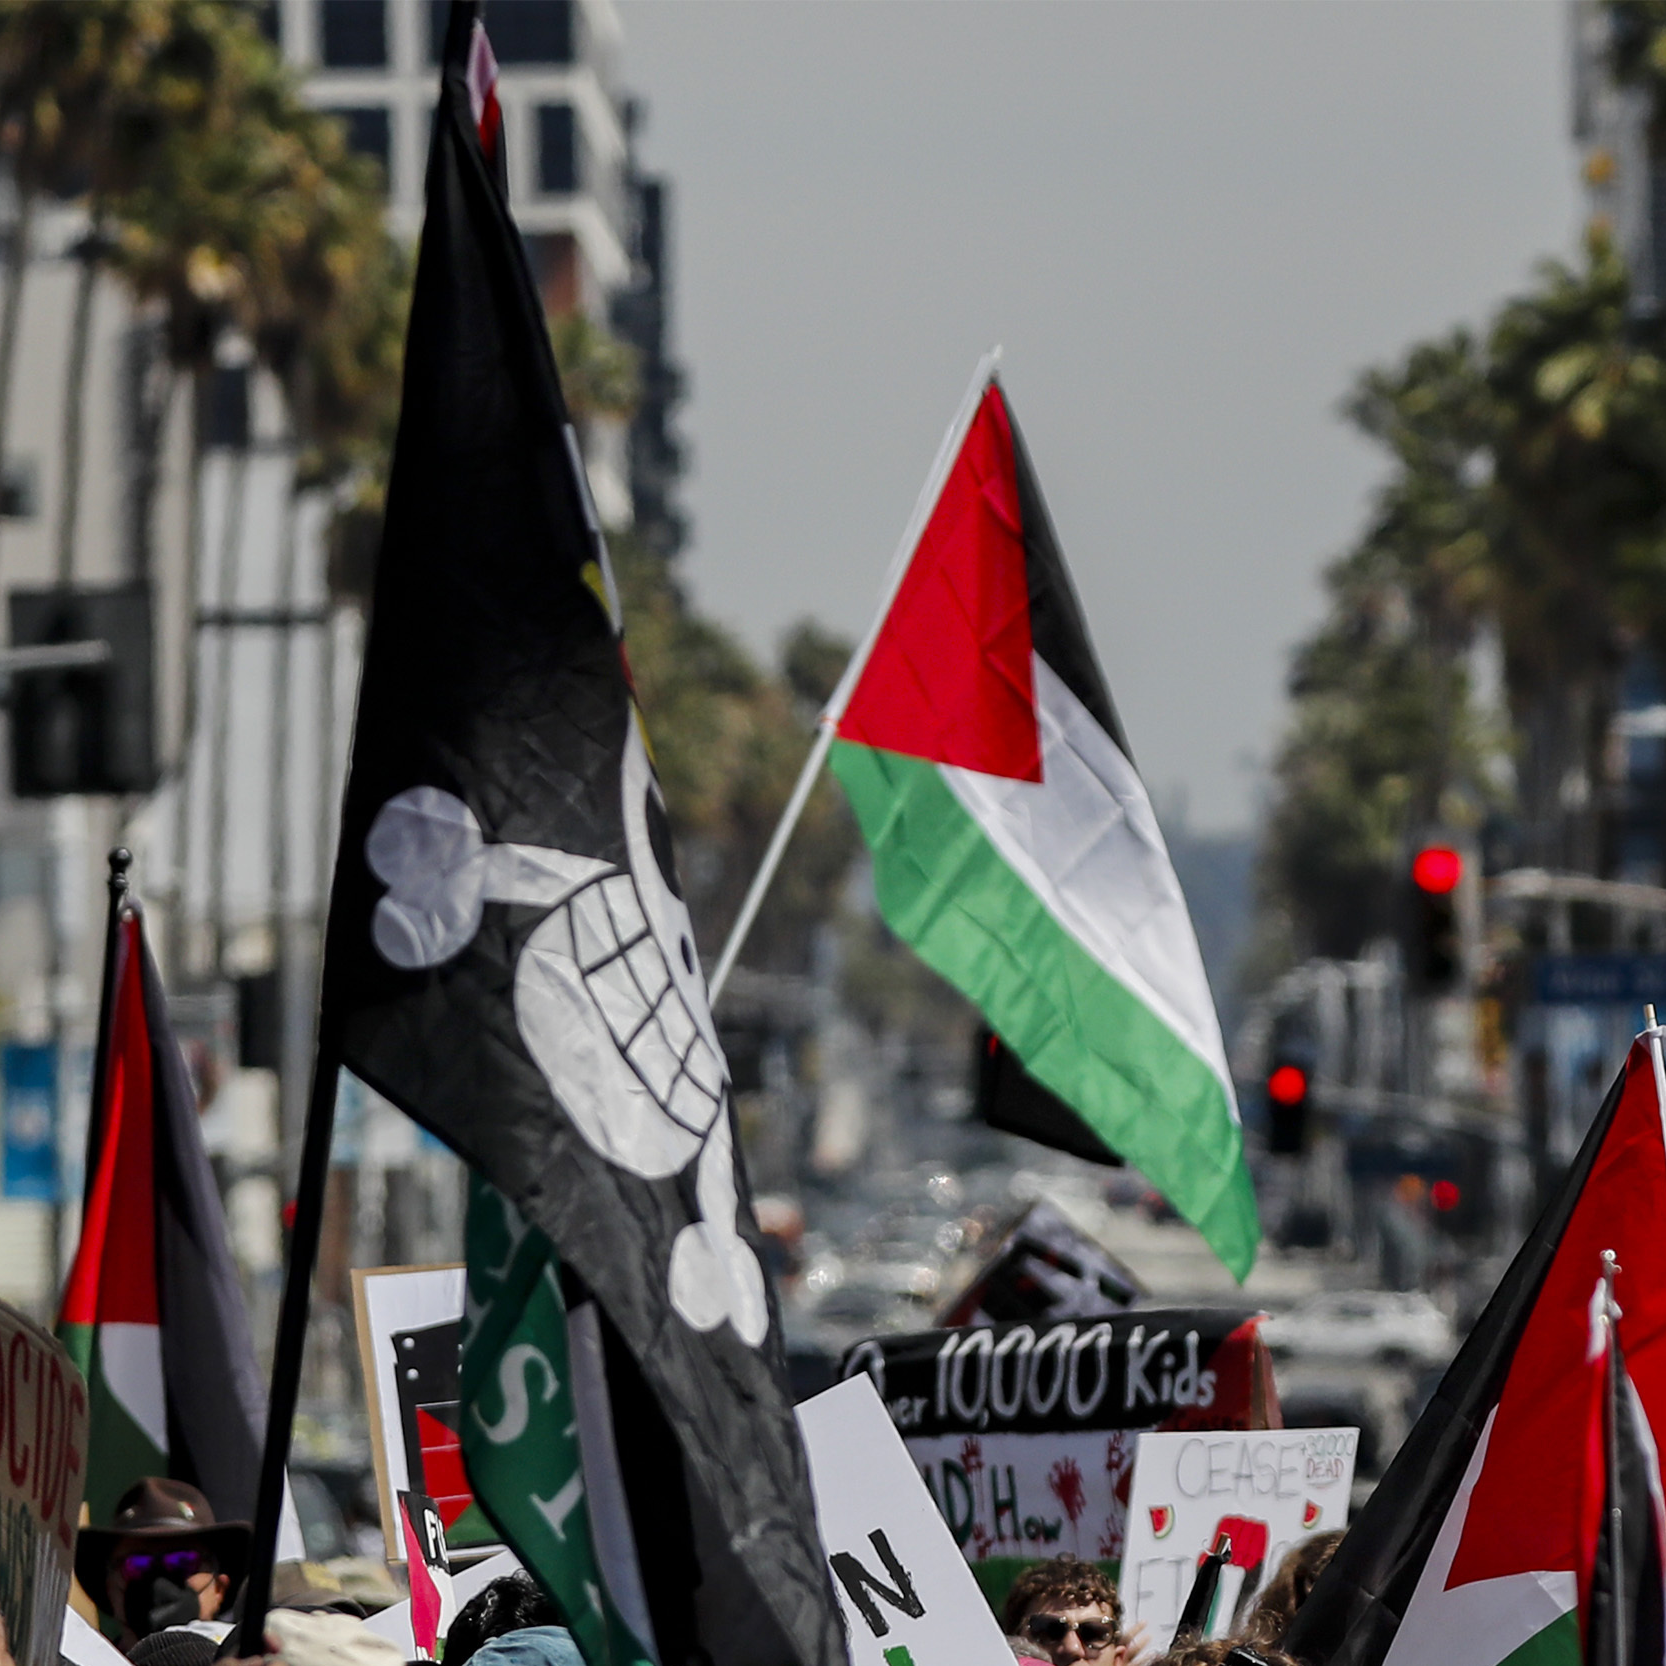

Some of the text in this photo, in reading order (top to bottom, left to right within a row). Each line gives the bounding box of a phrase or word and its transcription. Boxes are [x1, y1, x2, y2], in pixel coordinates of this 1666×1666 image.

[934, 1322, 1112, 1434] 10,000
[1123, 1323, 1219, 1411] Kids
[990, 1463, 1063, 1543] How
[1176, 1437, 1303, 1499] CEASE
[1306, 1457, 1345, 1483] DEAD
